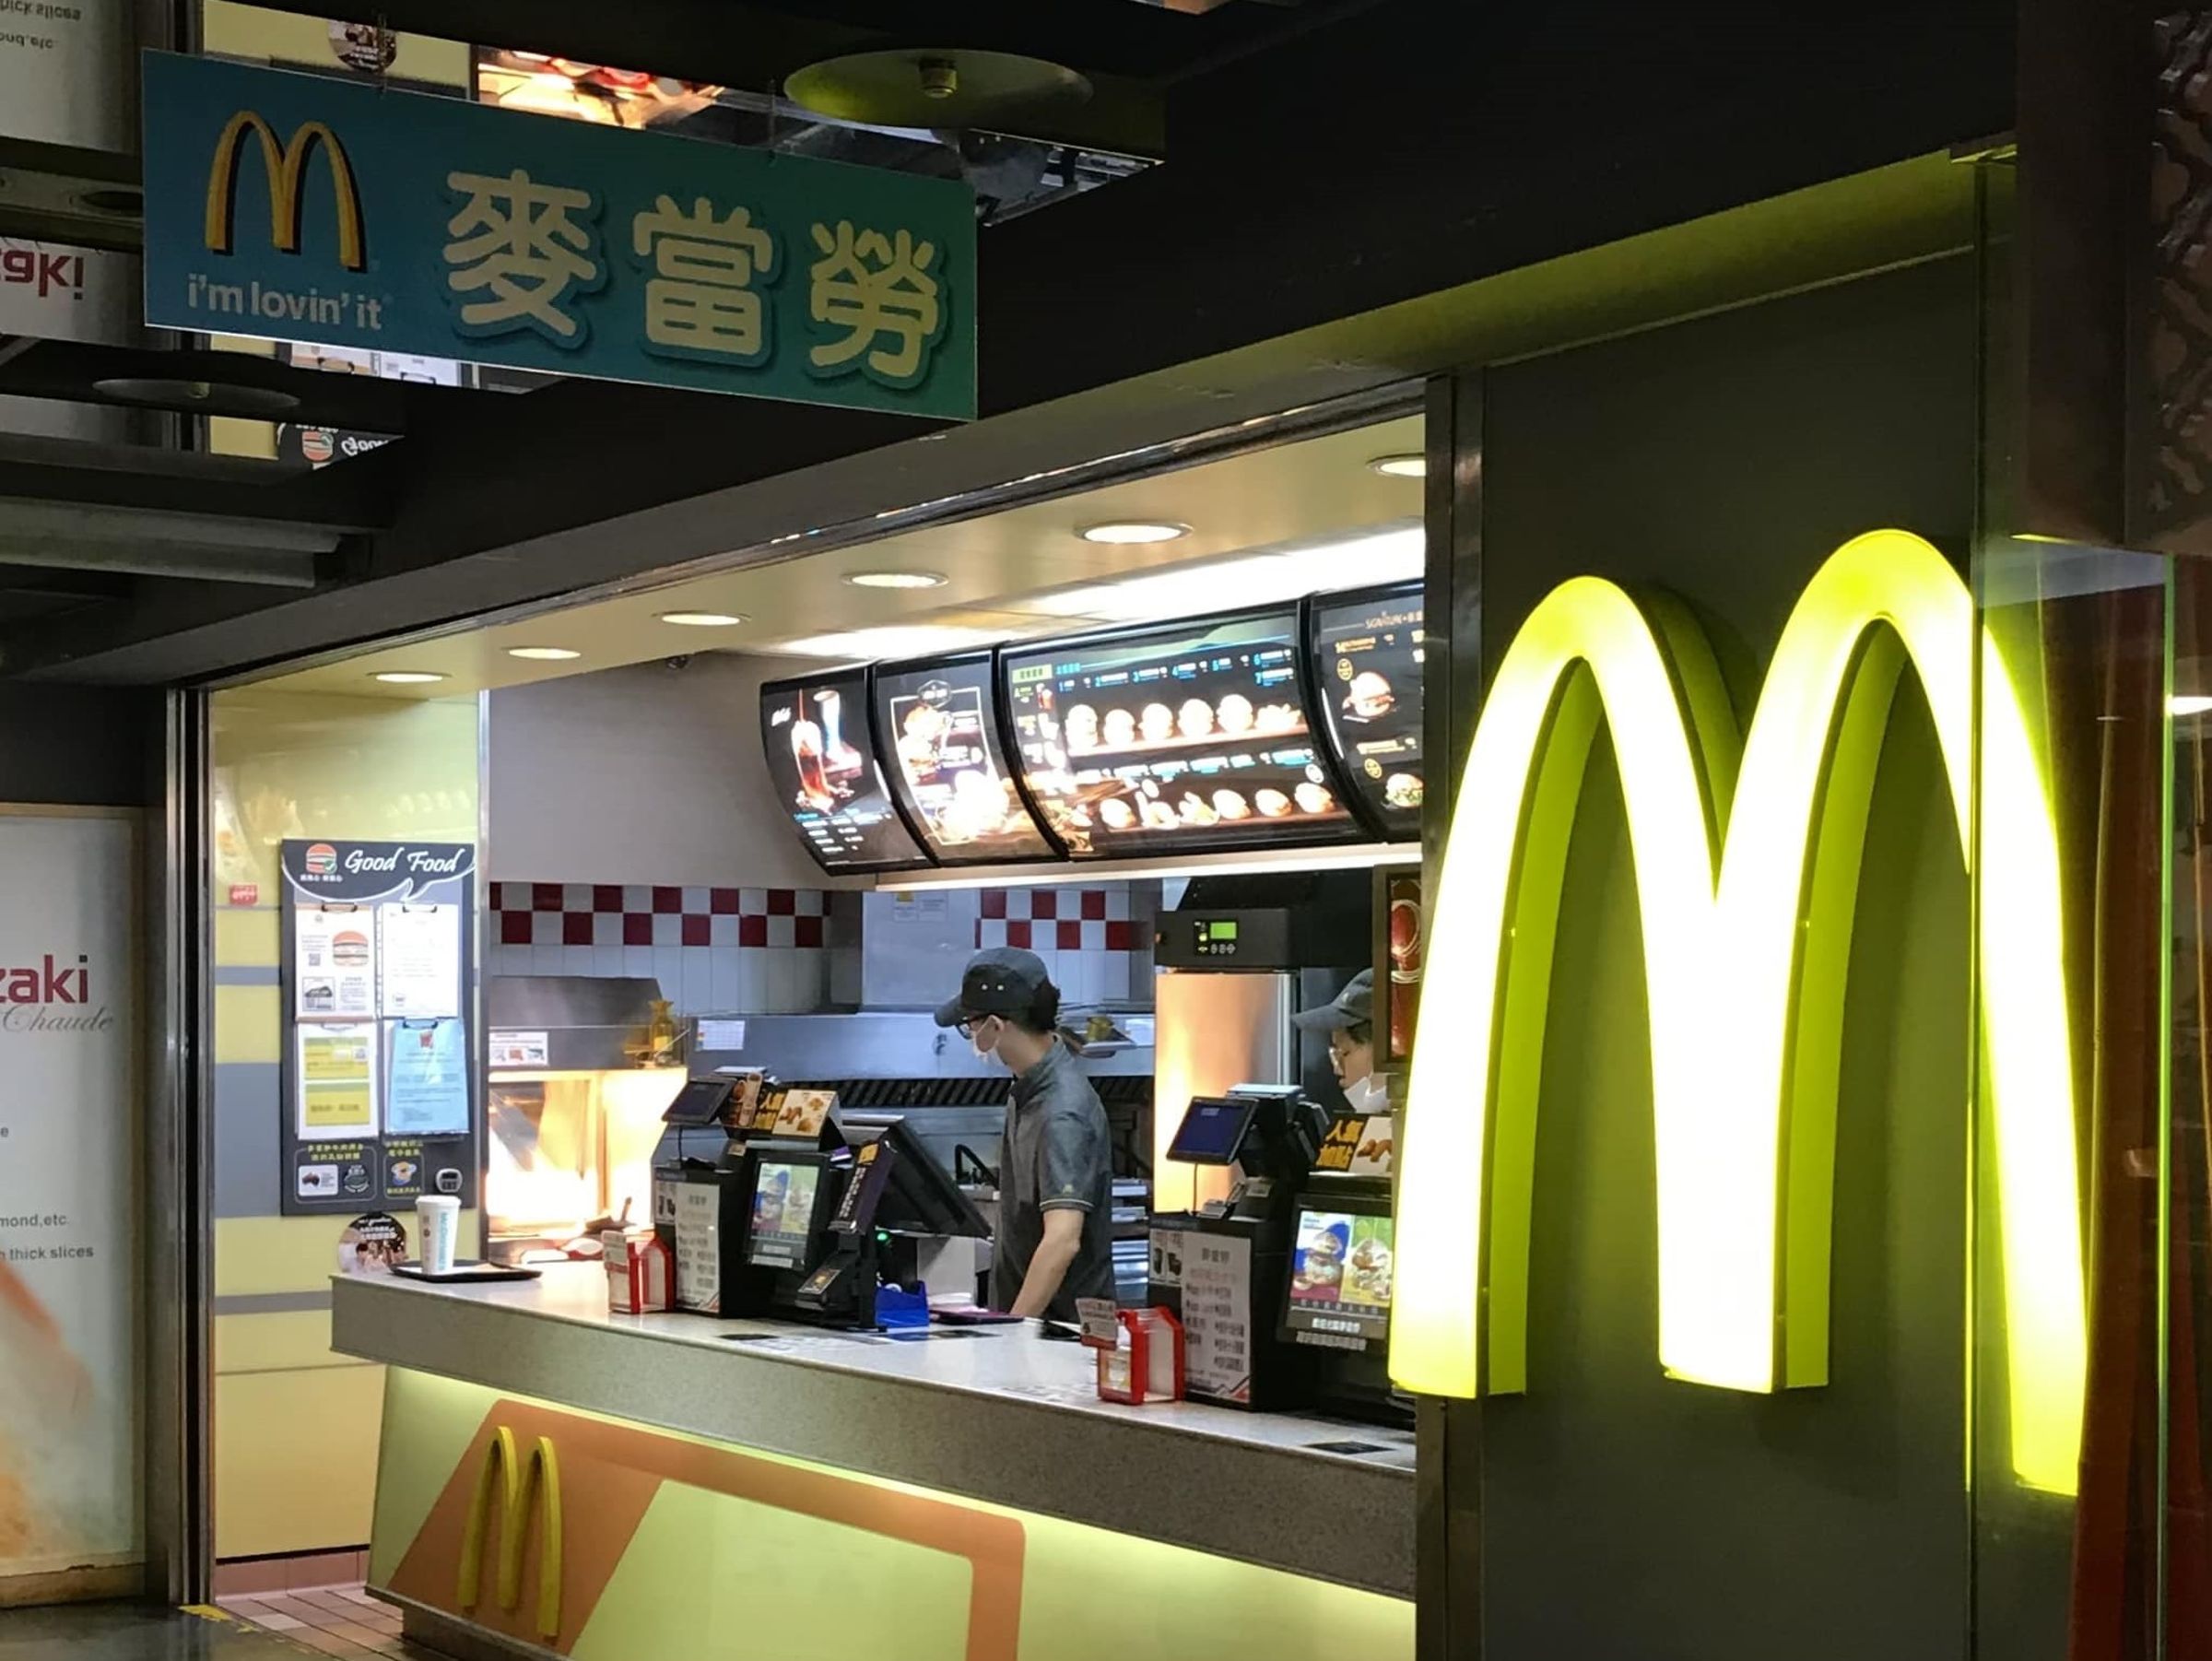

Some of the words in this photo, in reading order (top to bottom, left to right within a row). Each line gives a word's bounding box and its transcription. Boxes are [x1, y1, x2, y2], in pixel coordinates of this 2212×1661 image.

[442, 169, 939, 378] 麥當勞
[251, 281, 349, 324] lovin'
[357, 294, 382, 330] it
[345, 846, 405, 873] Good
[406, 848, 465, 872] Food
[0, 954, 88, 1004] aki
[9, 1247, 46, 1261] thick
[50, 1245, 95, 1259] slices
